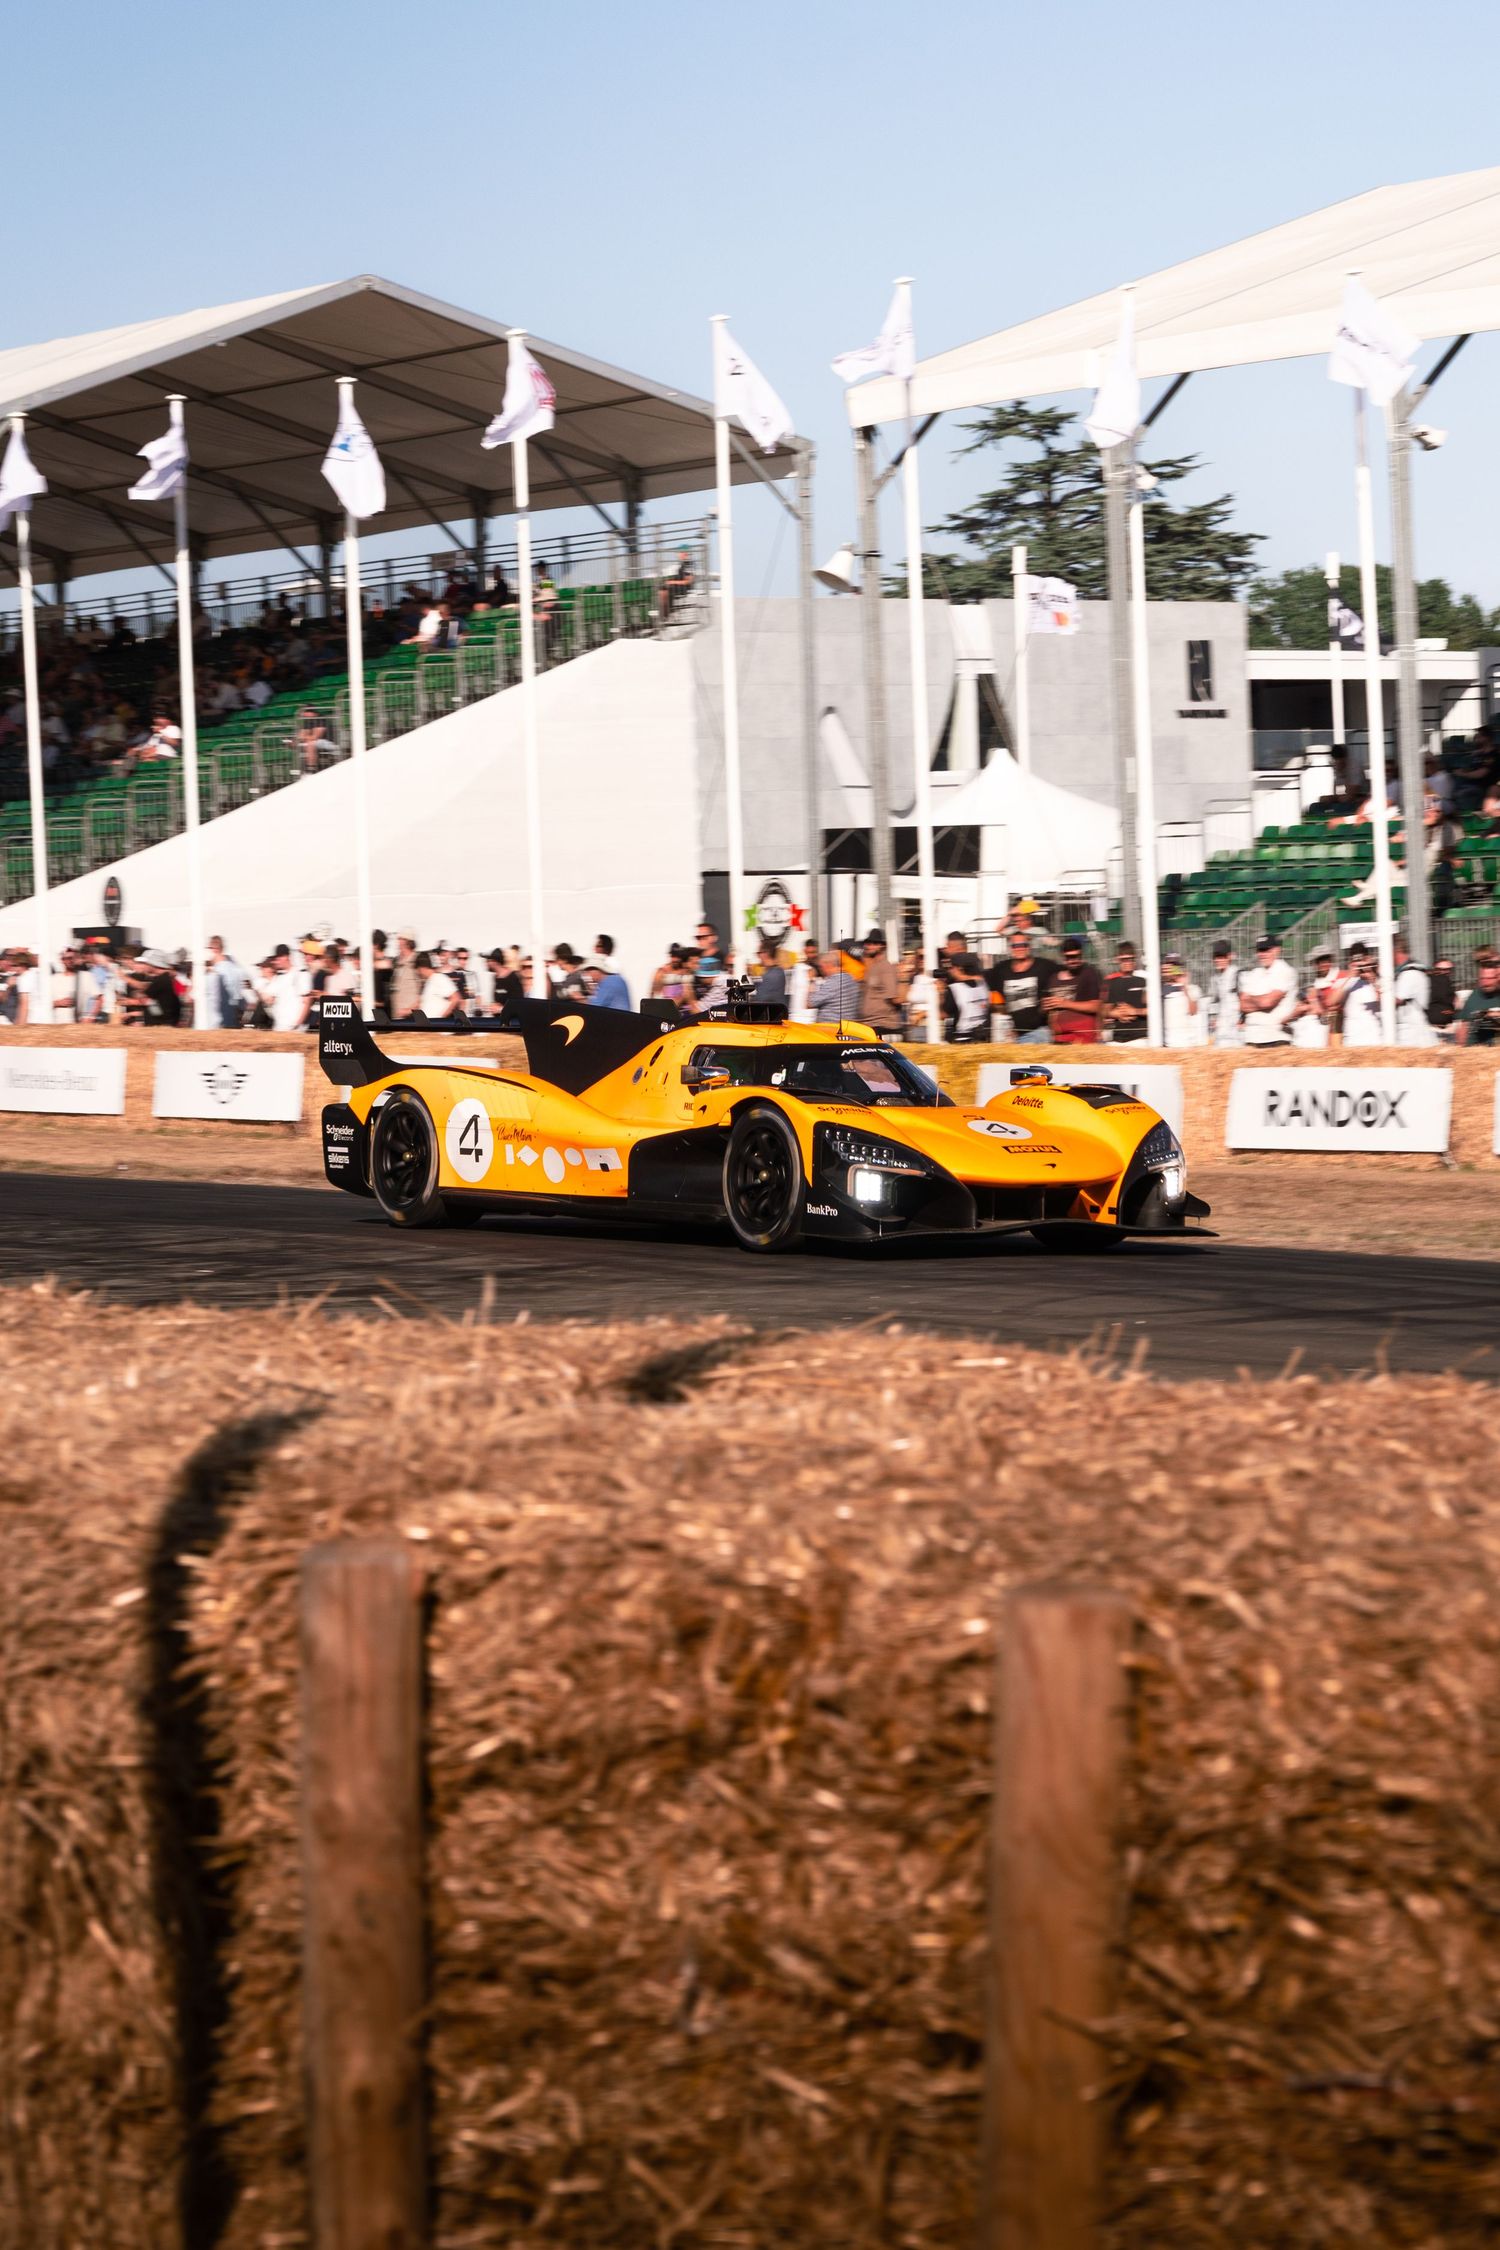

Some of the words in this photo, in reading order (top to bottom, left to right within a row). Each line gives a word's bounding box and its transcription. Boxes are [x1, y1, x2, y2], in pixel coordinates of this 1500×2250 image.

[325, 1004, 350, 1016] MOTUL
[323, 1039, 354, 1056] alteryx
[1264, 1089, 1409, 1129] RANDOX
[326, 1124, 354, 1136] Schneider
[986, 1123, 1018, 1135] 4
[459, 1114, 483, 1163] 4
[1006, 1145, 1060, 1153] MOTUL
[806, 1202, 838, 1217] BankPro
